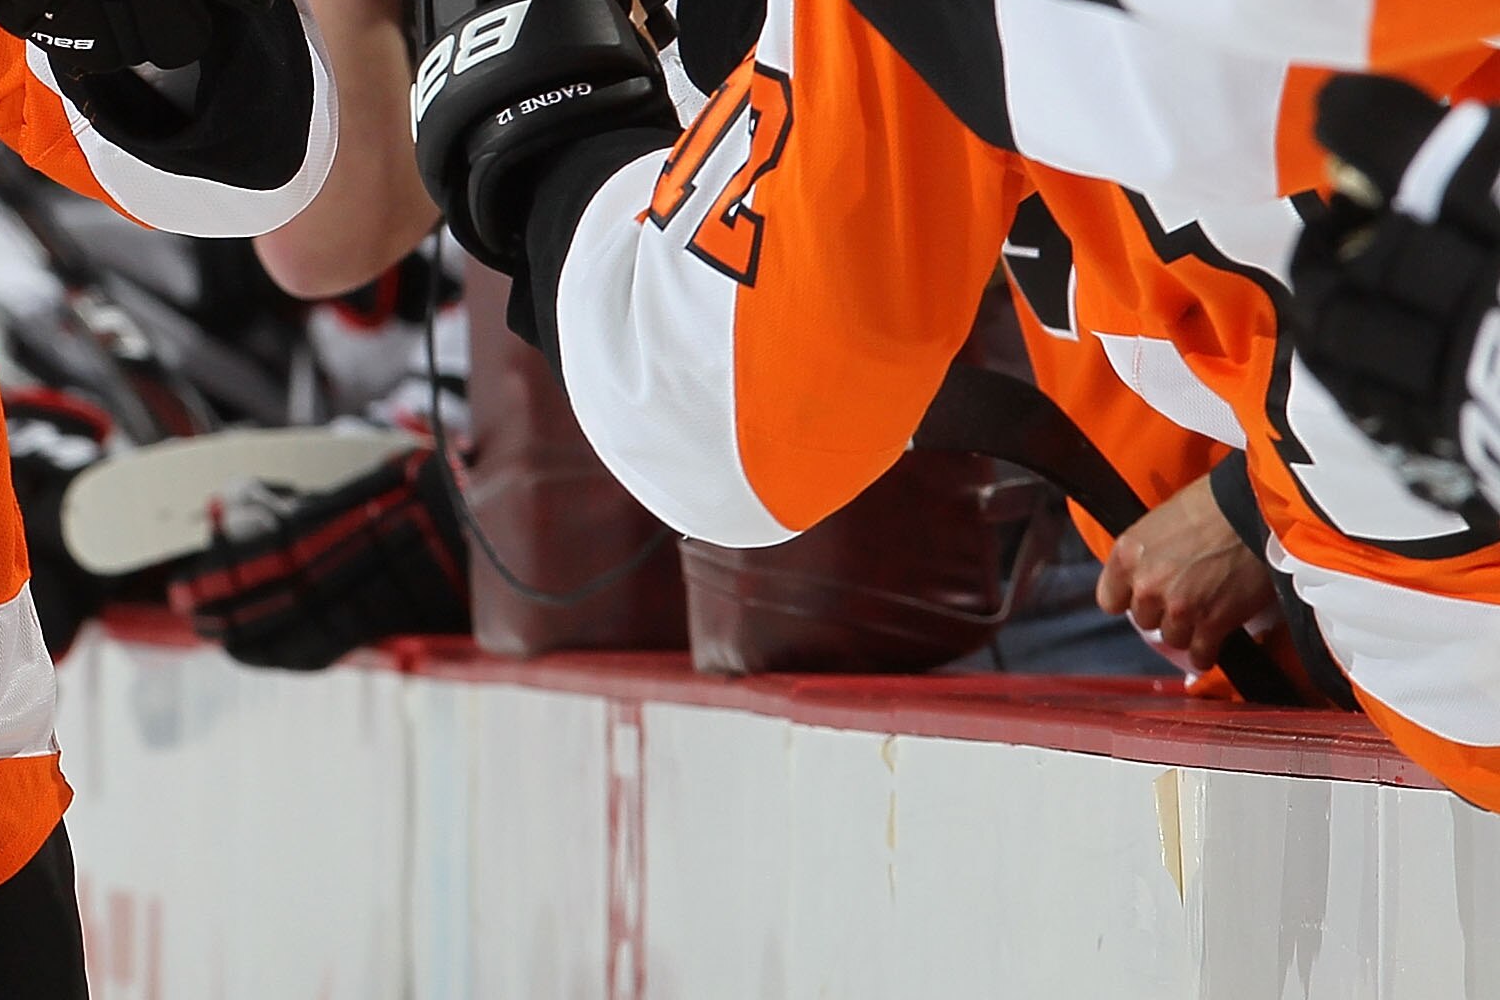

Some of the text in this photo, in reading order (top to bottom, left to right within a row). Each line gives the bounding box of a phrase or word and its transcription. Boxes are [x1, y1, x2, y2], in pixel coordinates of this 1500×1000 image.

[496, 82, 592, 126] GAGNE 12
[648, 60, 794, 289] 12
